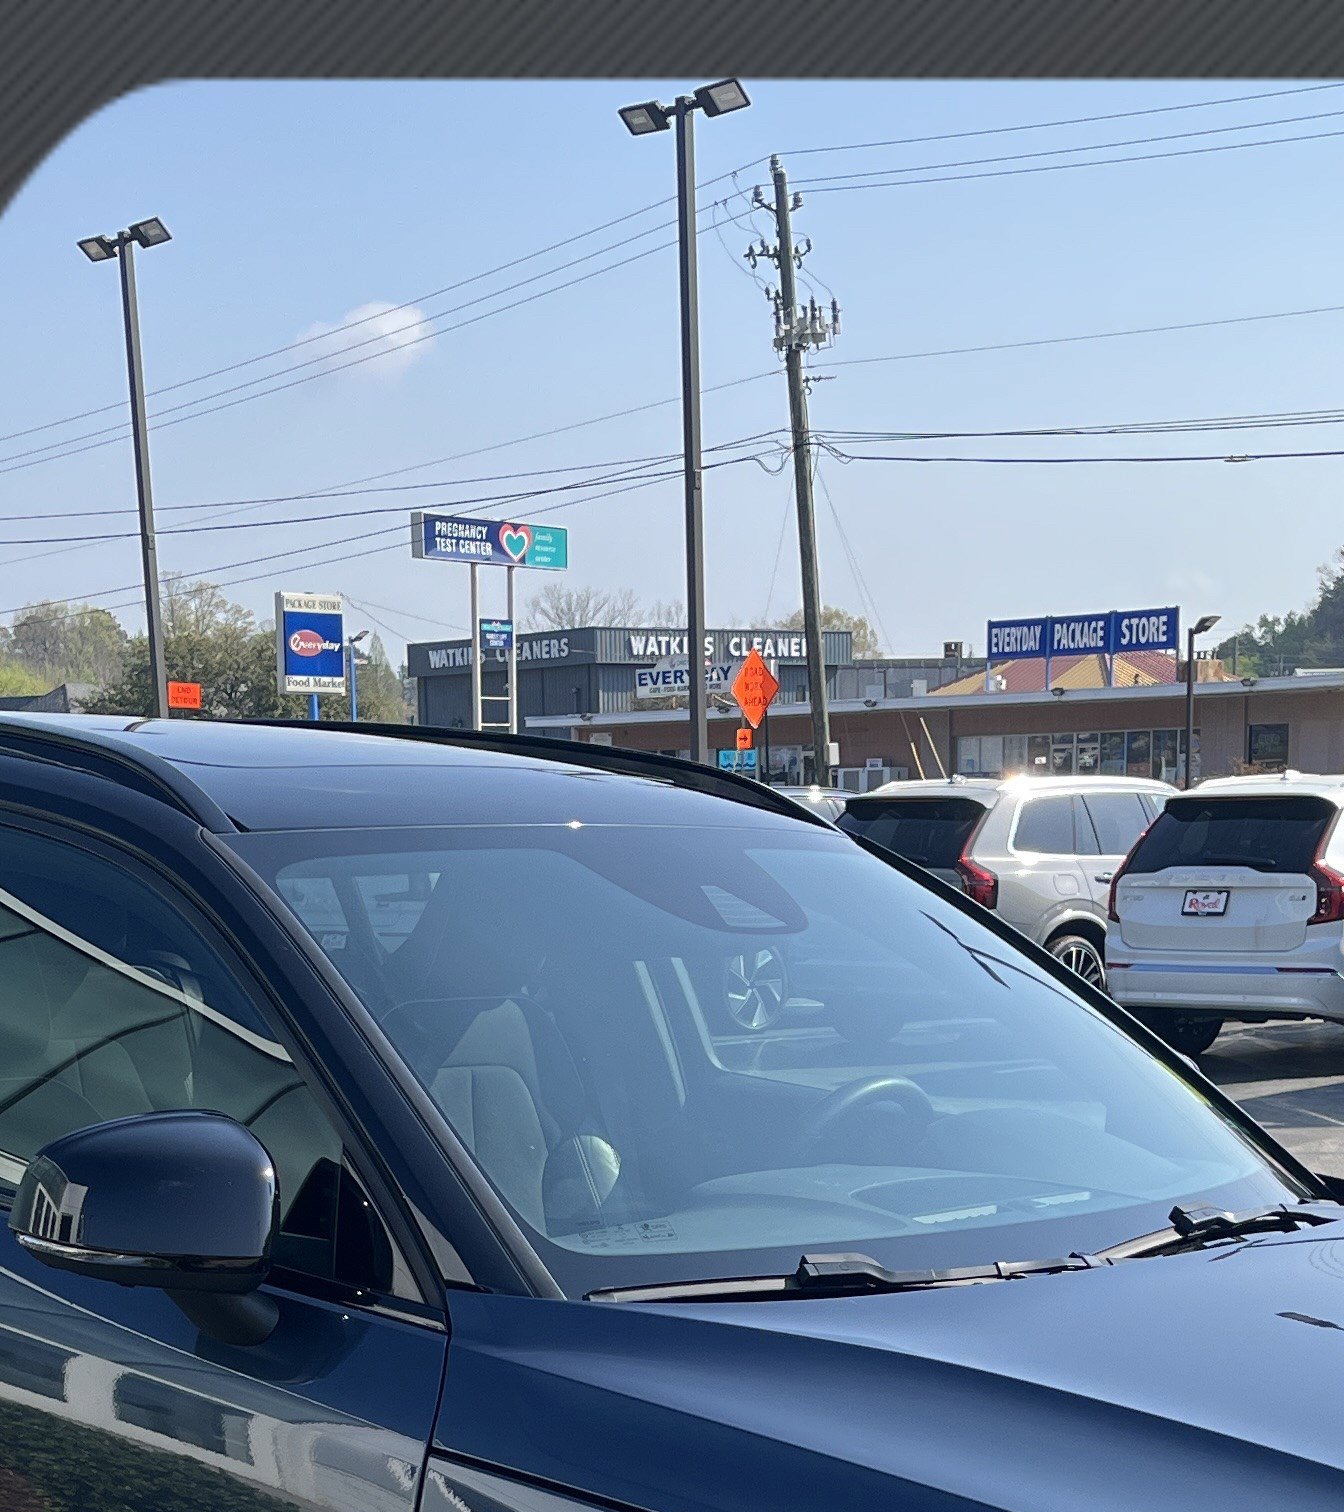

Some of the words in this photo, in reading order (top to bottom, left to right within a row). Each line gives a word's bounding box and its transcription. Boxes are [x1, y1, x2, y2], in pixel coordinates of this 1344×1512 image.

[435, 521, 488, 540] PREGNANCY
[435, 537, 457, 552] TEST
[459, 540, 493, 557] CENTER
[286, 599, 317, 610] PACKAGE
[319, 600, 342, 611] STORE
[991, 625, 1042, 653] EVERYDAY
[1054, 620, 1105, 650] PACKAGE
[1120, 615, 1168, 645] STORE
[630, 636, 715, 657] WATKIS
[744, 667, 763, 677] ROAD
[287, 677, 310, 688] Food
[744, 681, 763, 691] WORK
[177, 686, 192, 694] END
[171, 696, 197, 705] DETOUR
[744, 696, 767, 706] AHEAD
[1189, 897, 1220, 911] Royal
